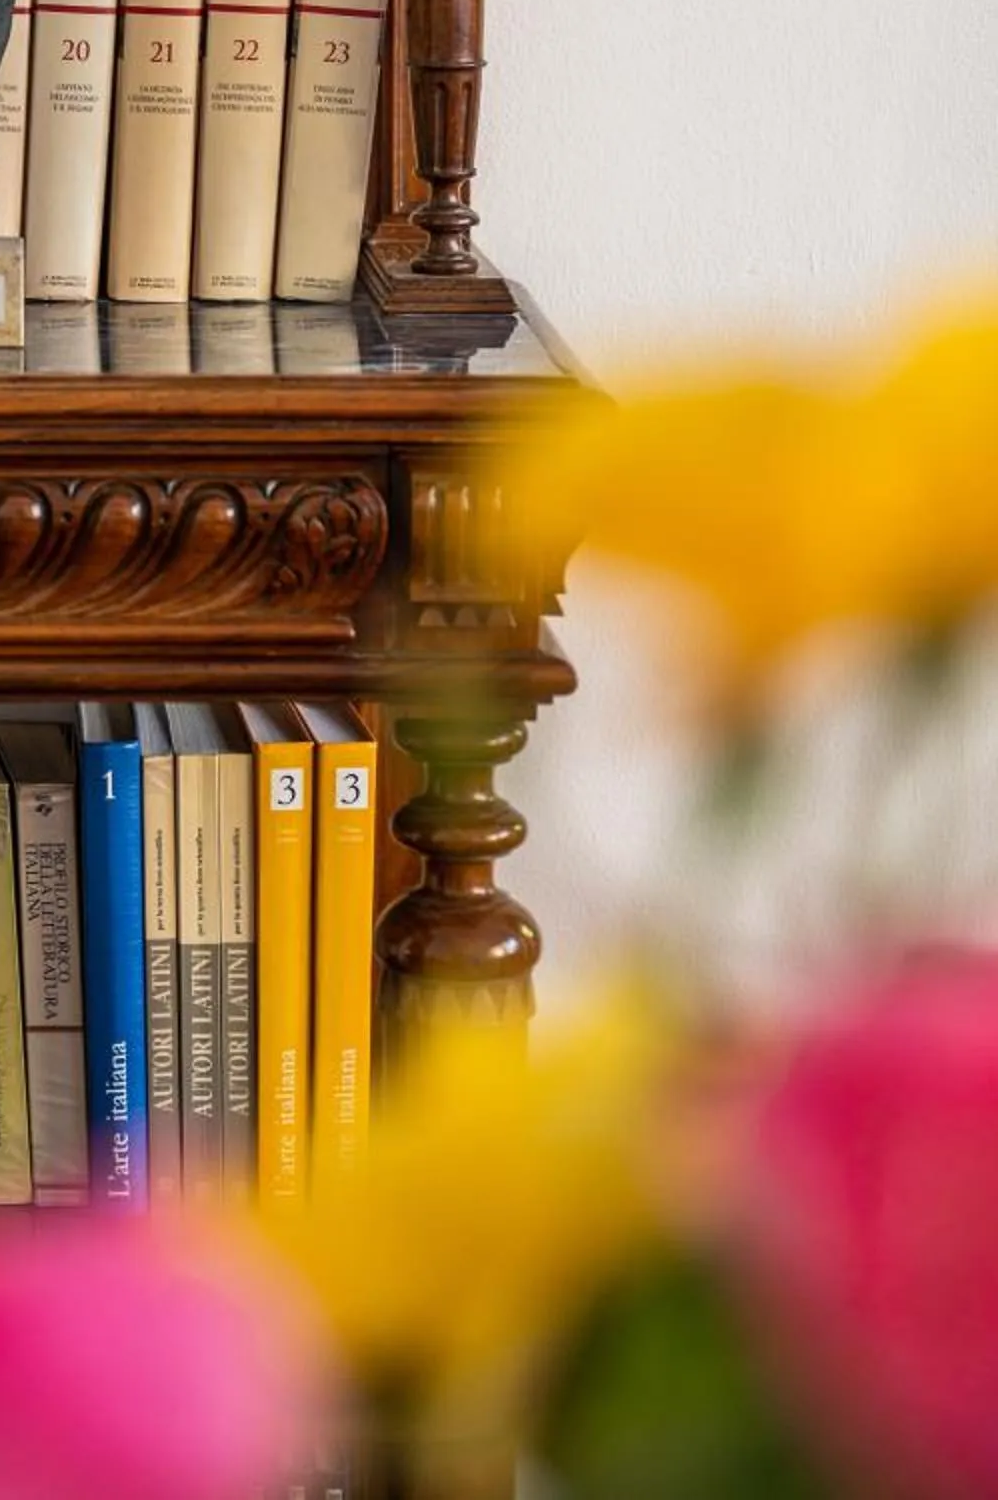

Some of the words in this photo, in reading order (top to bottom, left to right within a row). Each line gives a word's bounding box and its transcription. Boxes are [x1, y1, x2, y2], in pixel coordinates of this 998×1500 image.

[62, 40, 90, 61] 20
[150, 42, 173, 62] 21
[233, 40, 259, 61] 22
[323, 41, 350, 63] 23
[103, 770, 117, 799] 1
[277, 775, 296, 805] 3
[340, 773, 360, 804] 3
[25, 843, 40, 922] ITALIANA
[40, 843, 53, 896] DELLA
[54, 843, 68, 909] PROFILO
[41, 902, 59, 1020] LETTERATURA
[56, 912, 71, 984] STORICO
[152, 945, 171, 1019] LATINI
[191, 950, 212, 1023] LATINI
[227, 949, 249, 1022] LATINI
[106, 1041, 127, 1121] italiana
[153, 1028, 173, 1112] AUTORI
[192, 1033, 213, 1117] AUTORI
[228, 1032, 249, 1116] AUTORI
[275, 1049, 296, 1124] italiana
[333, 1048, 356, 1123] italiana
[108, 1133, 130, 1197] L'arte
